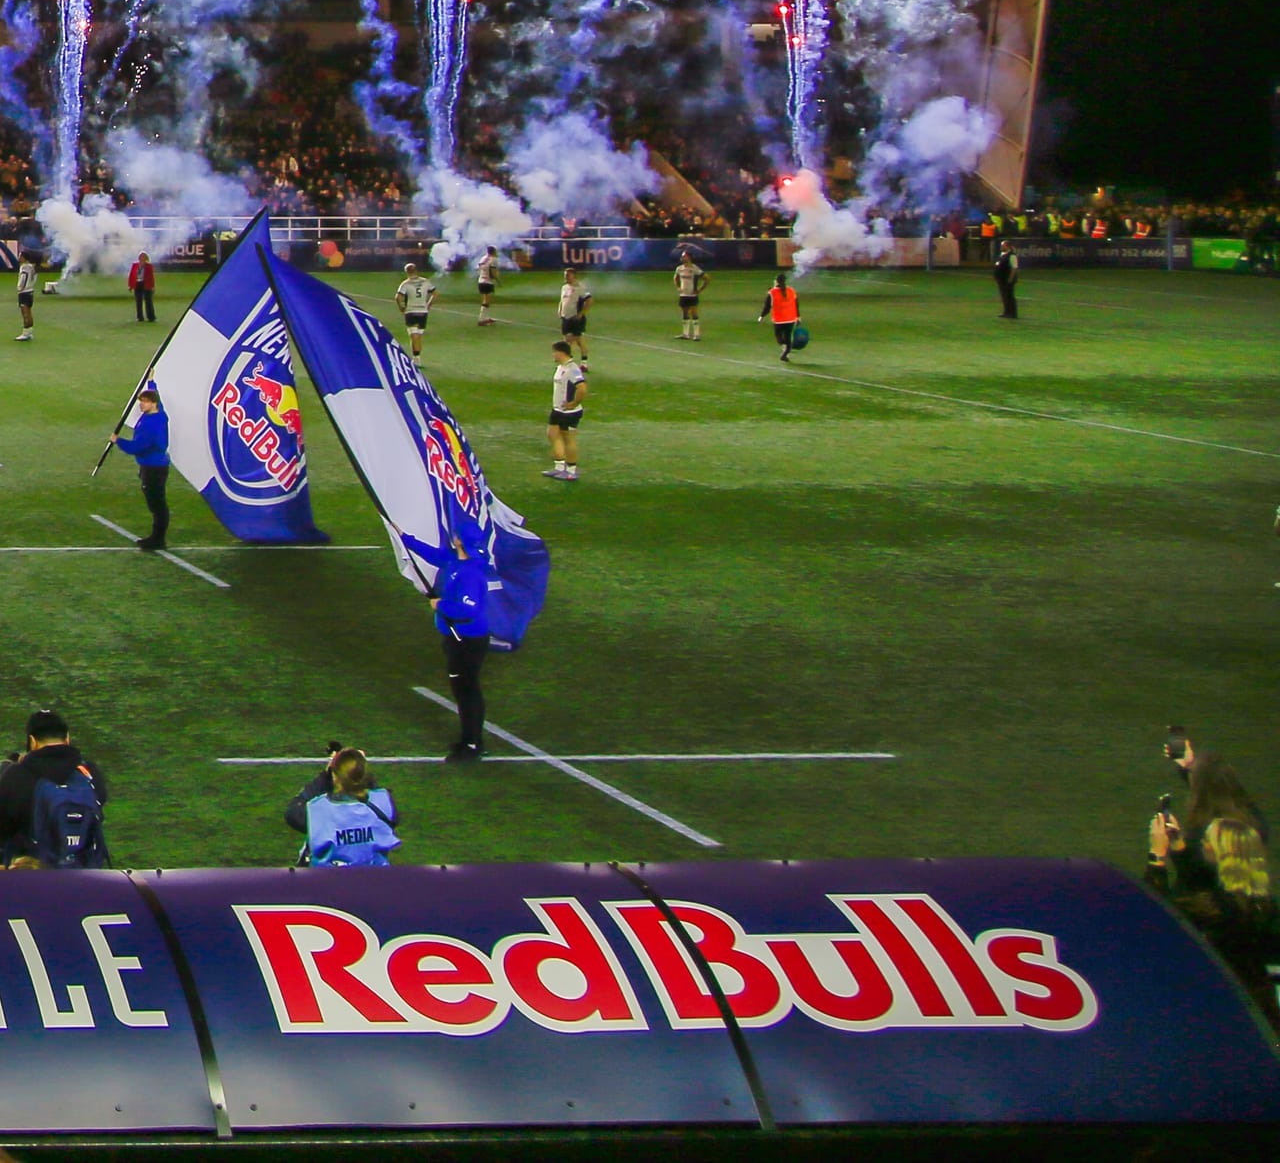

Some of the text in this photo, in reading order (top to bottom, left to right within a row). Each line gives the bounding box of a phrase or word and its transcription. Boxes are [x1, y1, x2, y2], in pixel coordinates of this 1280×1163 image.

[562, 242, 624, 265] lumo
[415, 287, 423, 299] 5
[66, 835, 81, 846] TW
[335, 826, 375, 847] MEDIA
